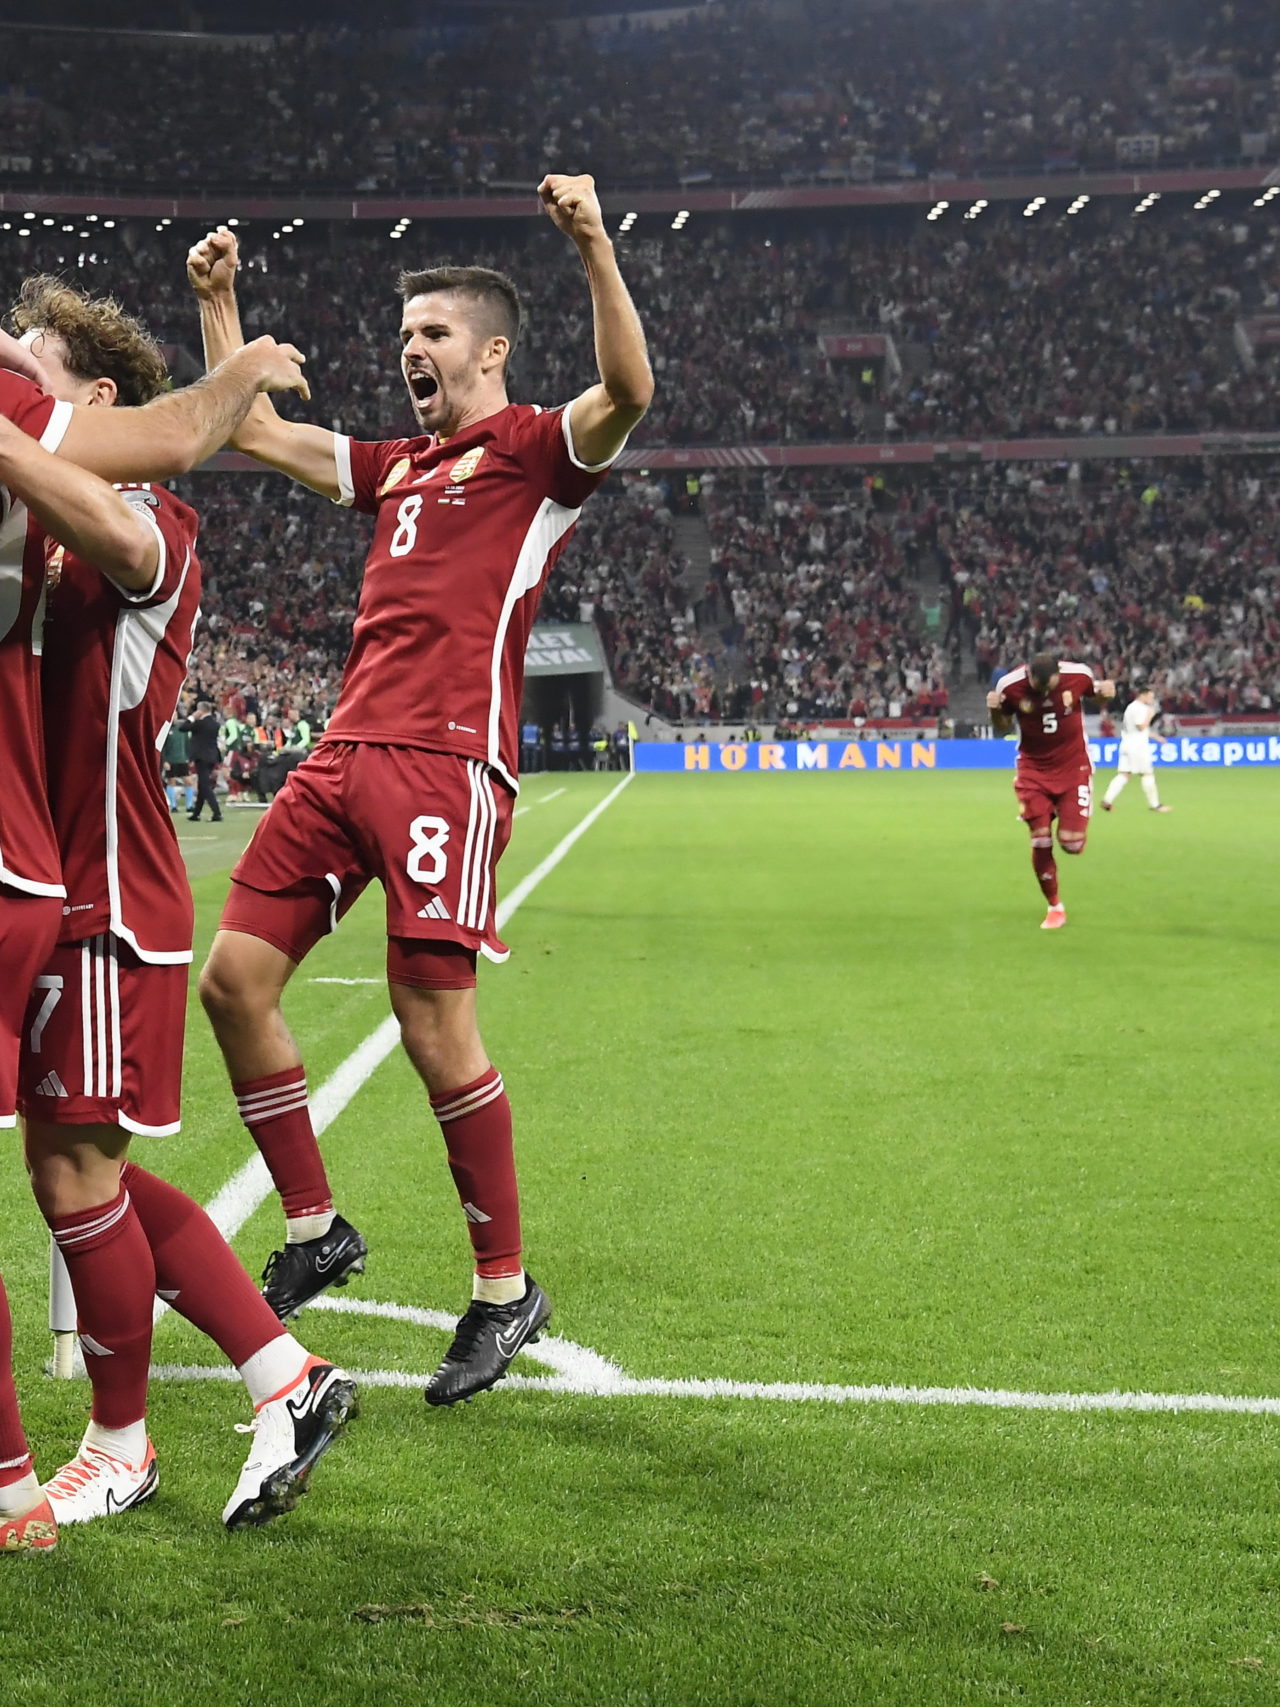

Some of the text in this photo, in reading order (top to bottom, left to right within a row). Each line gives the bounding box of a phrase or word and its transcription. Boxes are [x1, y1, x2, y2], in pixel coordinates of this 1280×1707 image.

[389, 493, 423, 558] 8
[528, 631, 577, 650] LET
[1042, 712, 1058, 734] 5
[684, 742, 937, 770] HÖRMANN
[1077, 785, 1091, 807] 5
[406, 815, 451, 885] 8
[30, 974, 64, 1053] 7
